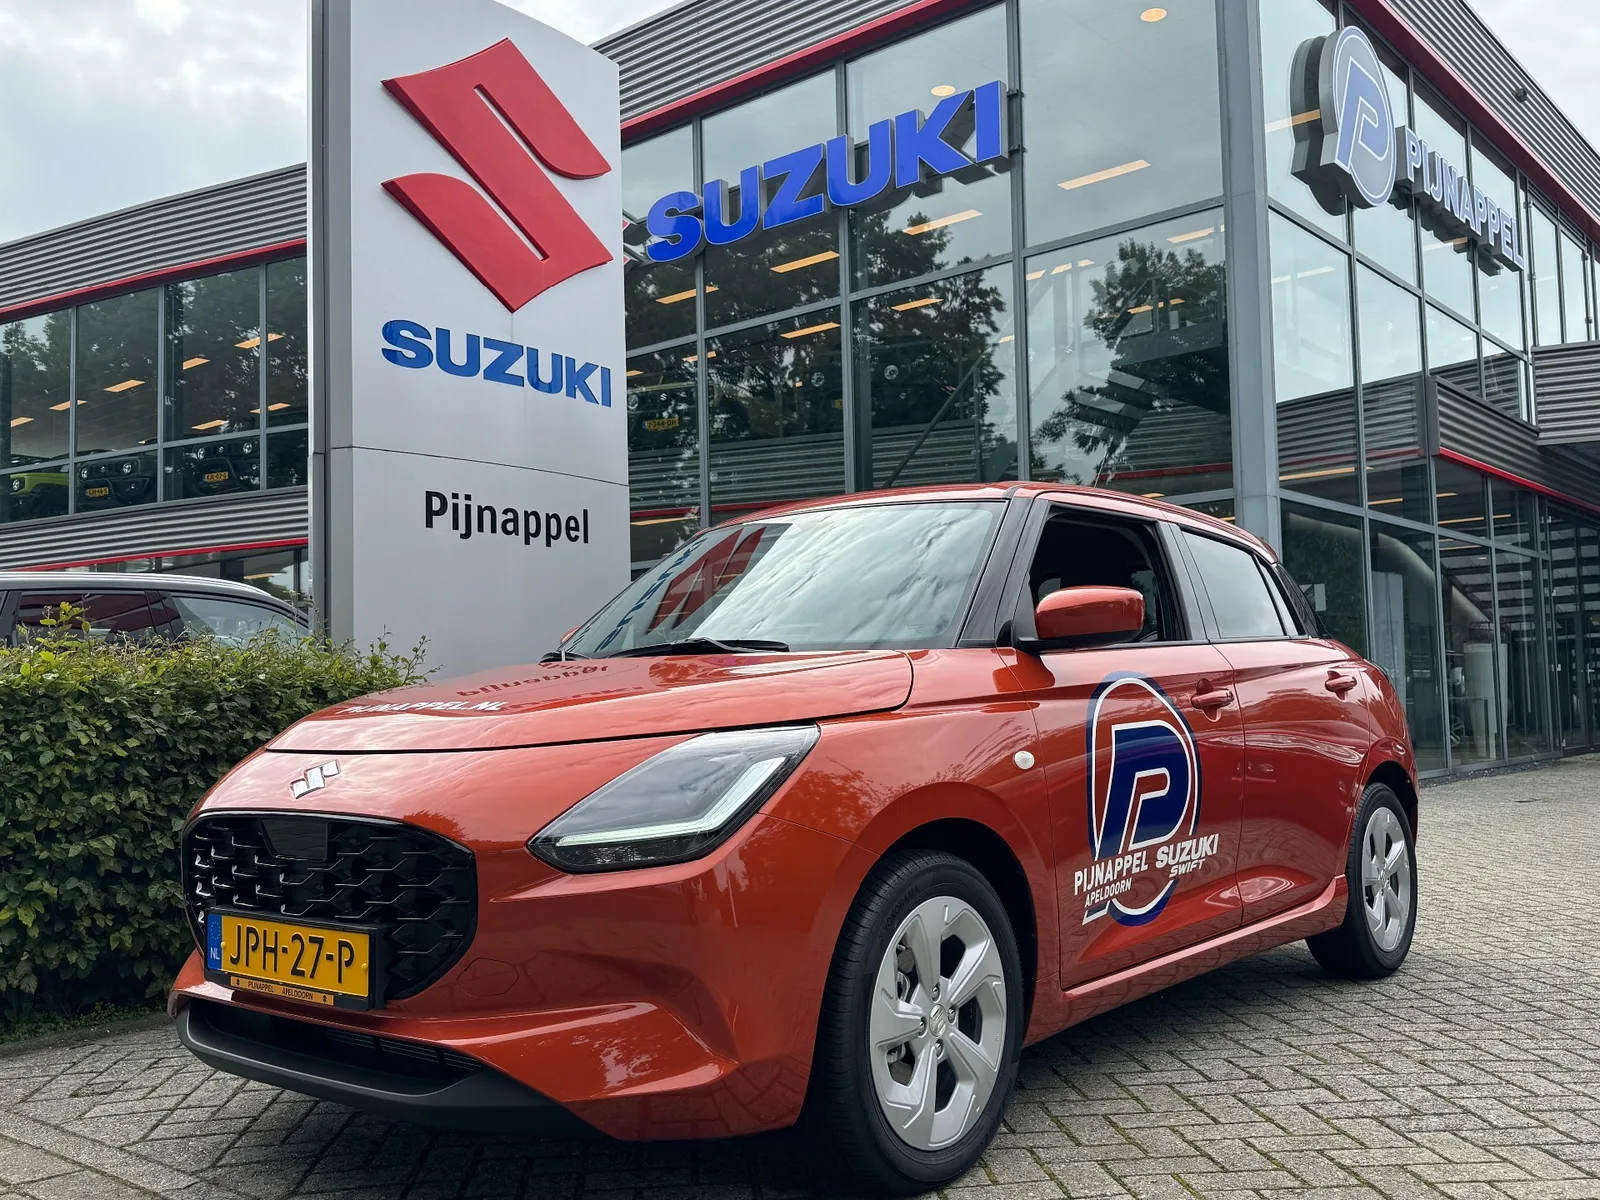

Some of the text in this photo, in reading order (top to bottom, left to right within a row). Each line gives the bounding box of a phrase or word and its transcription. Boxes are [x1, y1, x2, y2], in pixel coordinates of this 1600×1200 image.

[645, 80, 1004, 264] SUZUKI
[1405, 127, 1524, 270] PIJNAPPEL
[380, 319, 612, 408] SUZUKI
[425, 490, 590, 548] Pijnappel
[1074, 833, 1219, 896] PIJNAPPEL SUZUKI
[1084, 878, 1132, 908] APELDOORN
[1169, 858, 1205, 878] SWIFT
[210, 924, 355, 984] NL JPH-27-P
